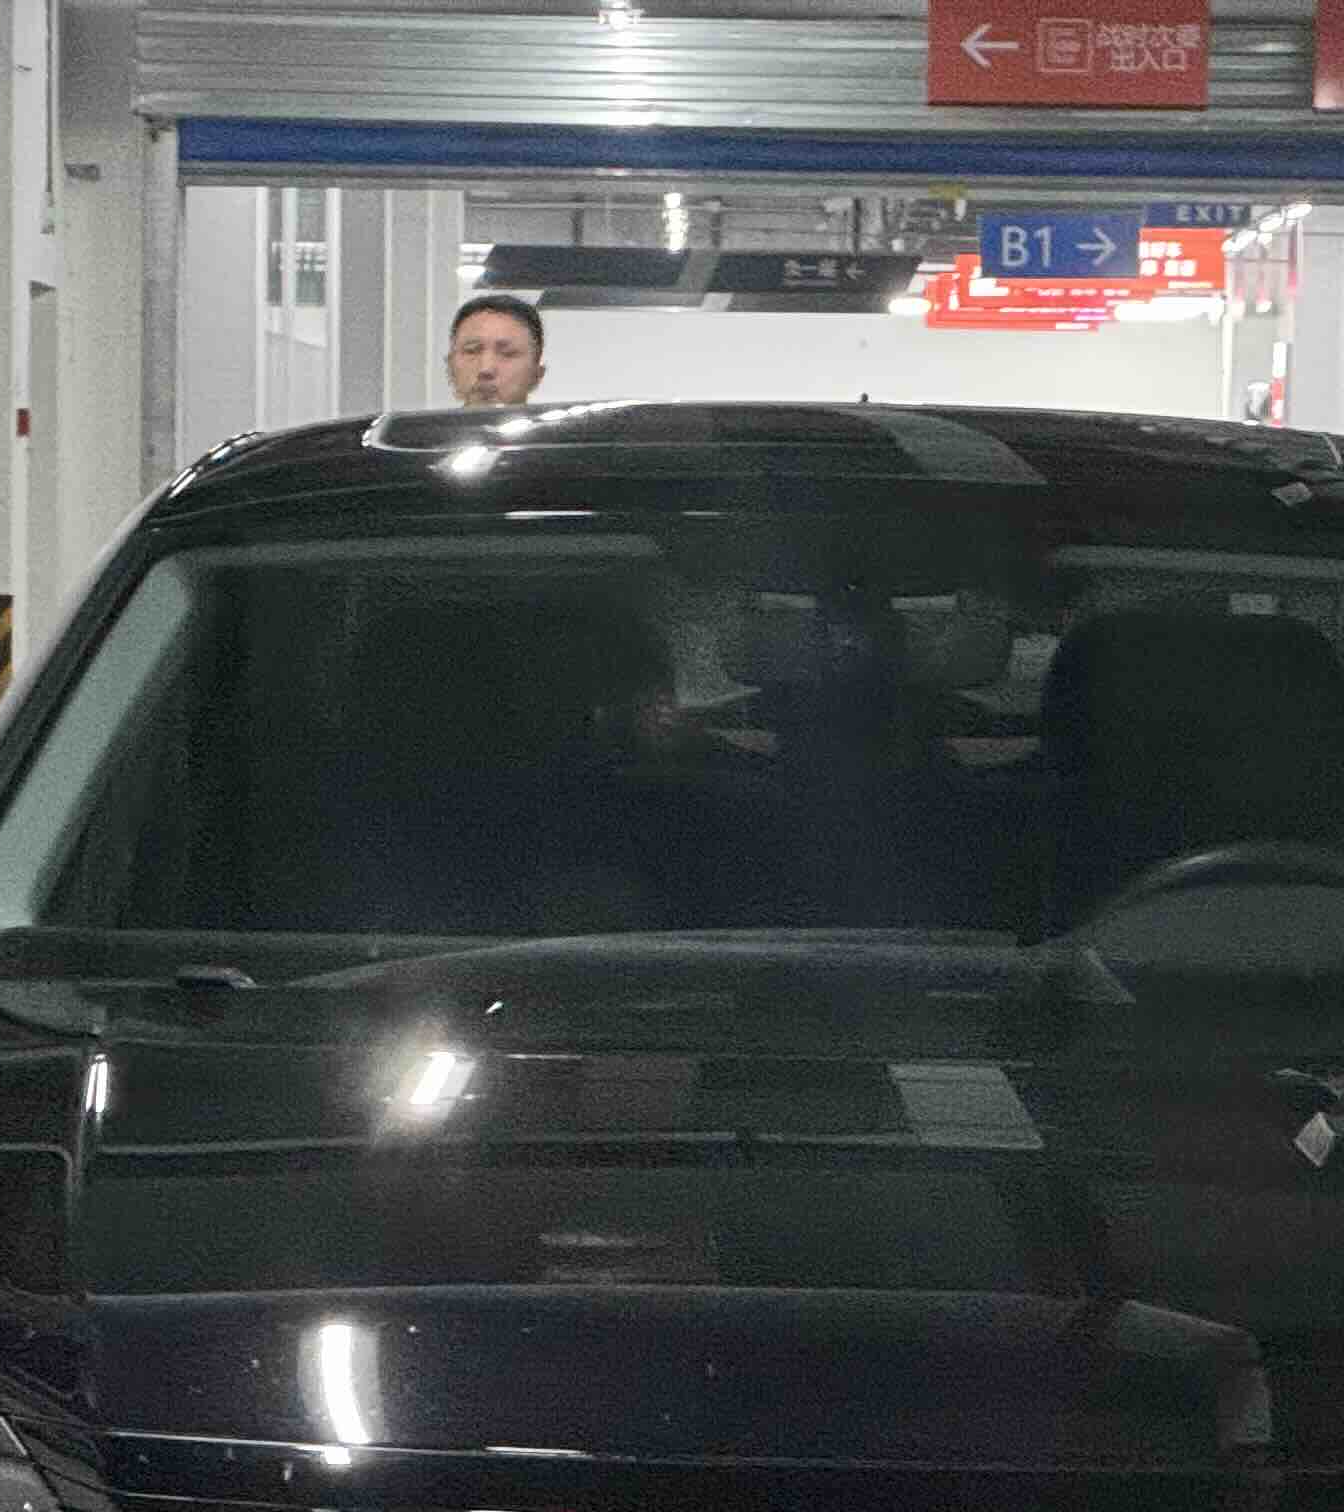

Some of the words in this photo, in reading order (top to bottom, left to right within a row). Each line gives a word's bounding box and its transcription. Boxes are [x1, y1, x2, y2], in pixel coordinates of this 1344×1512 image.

[1110, 49, 1186, 71] 出入口
[1176, 204, 1244, 222] EXIT
[1001, 225, 1052, 267] B1
